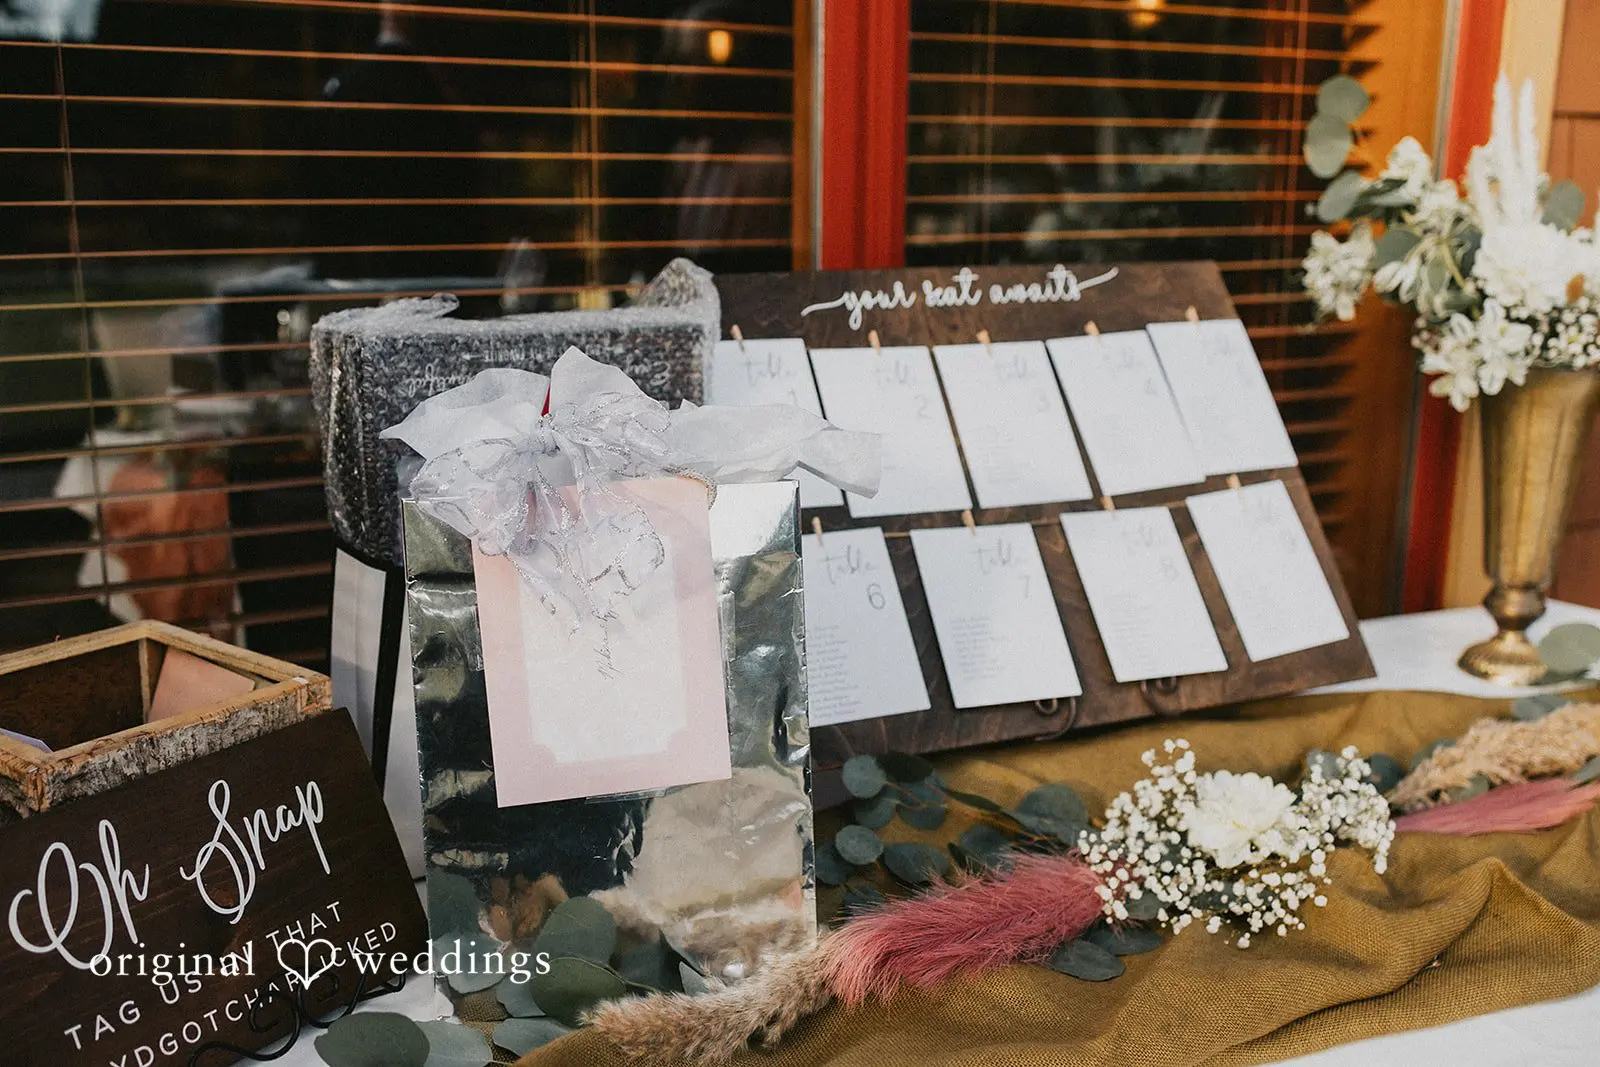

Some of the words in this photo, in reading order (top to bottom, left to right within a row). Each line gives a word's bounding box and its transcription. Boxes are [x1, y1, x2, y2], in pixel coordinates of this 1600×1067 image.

[801, 281, 917, 331] your
[989, 264, 1119, 304] awaits
[817, 544, 879, 586] table
[866, 583, 887, 611] 6
[8, 819, 150, 970] Oh
[179, 779, 332, 925] Snap
[63, 999, 142, 1051] TAG
[159, 969, 202, 1005] US
[265, 900, 343, 952] THAT
